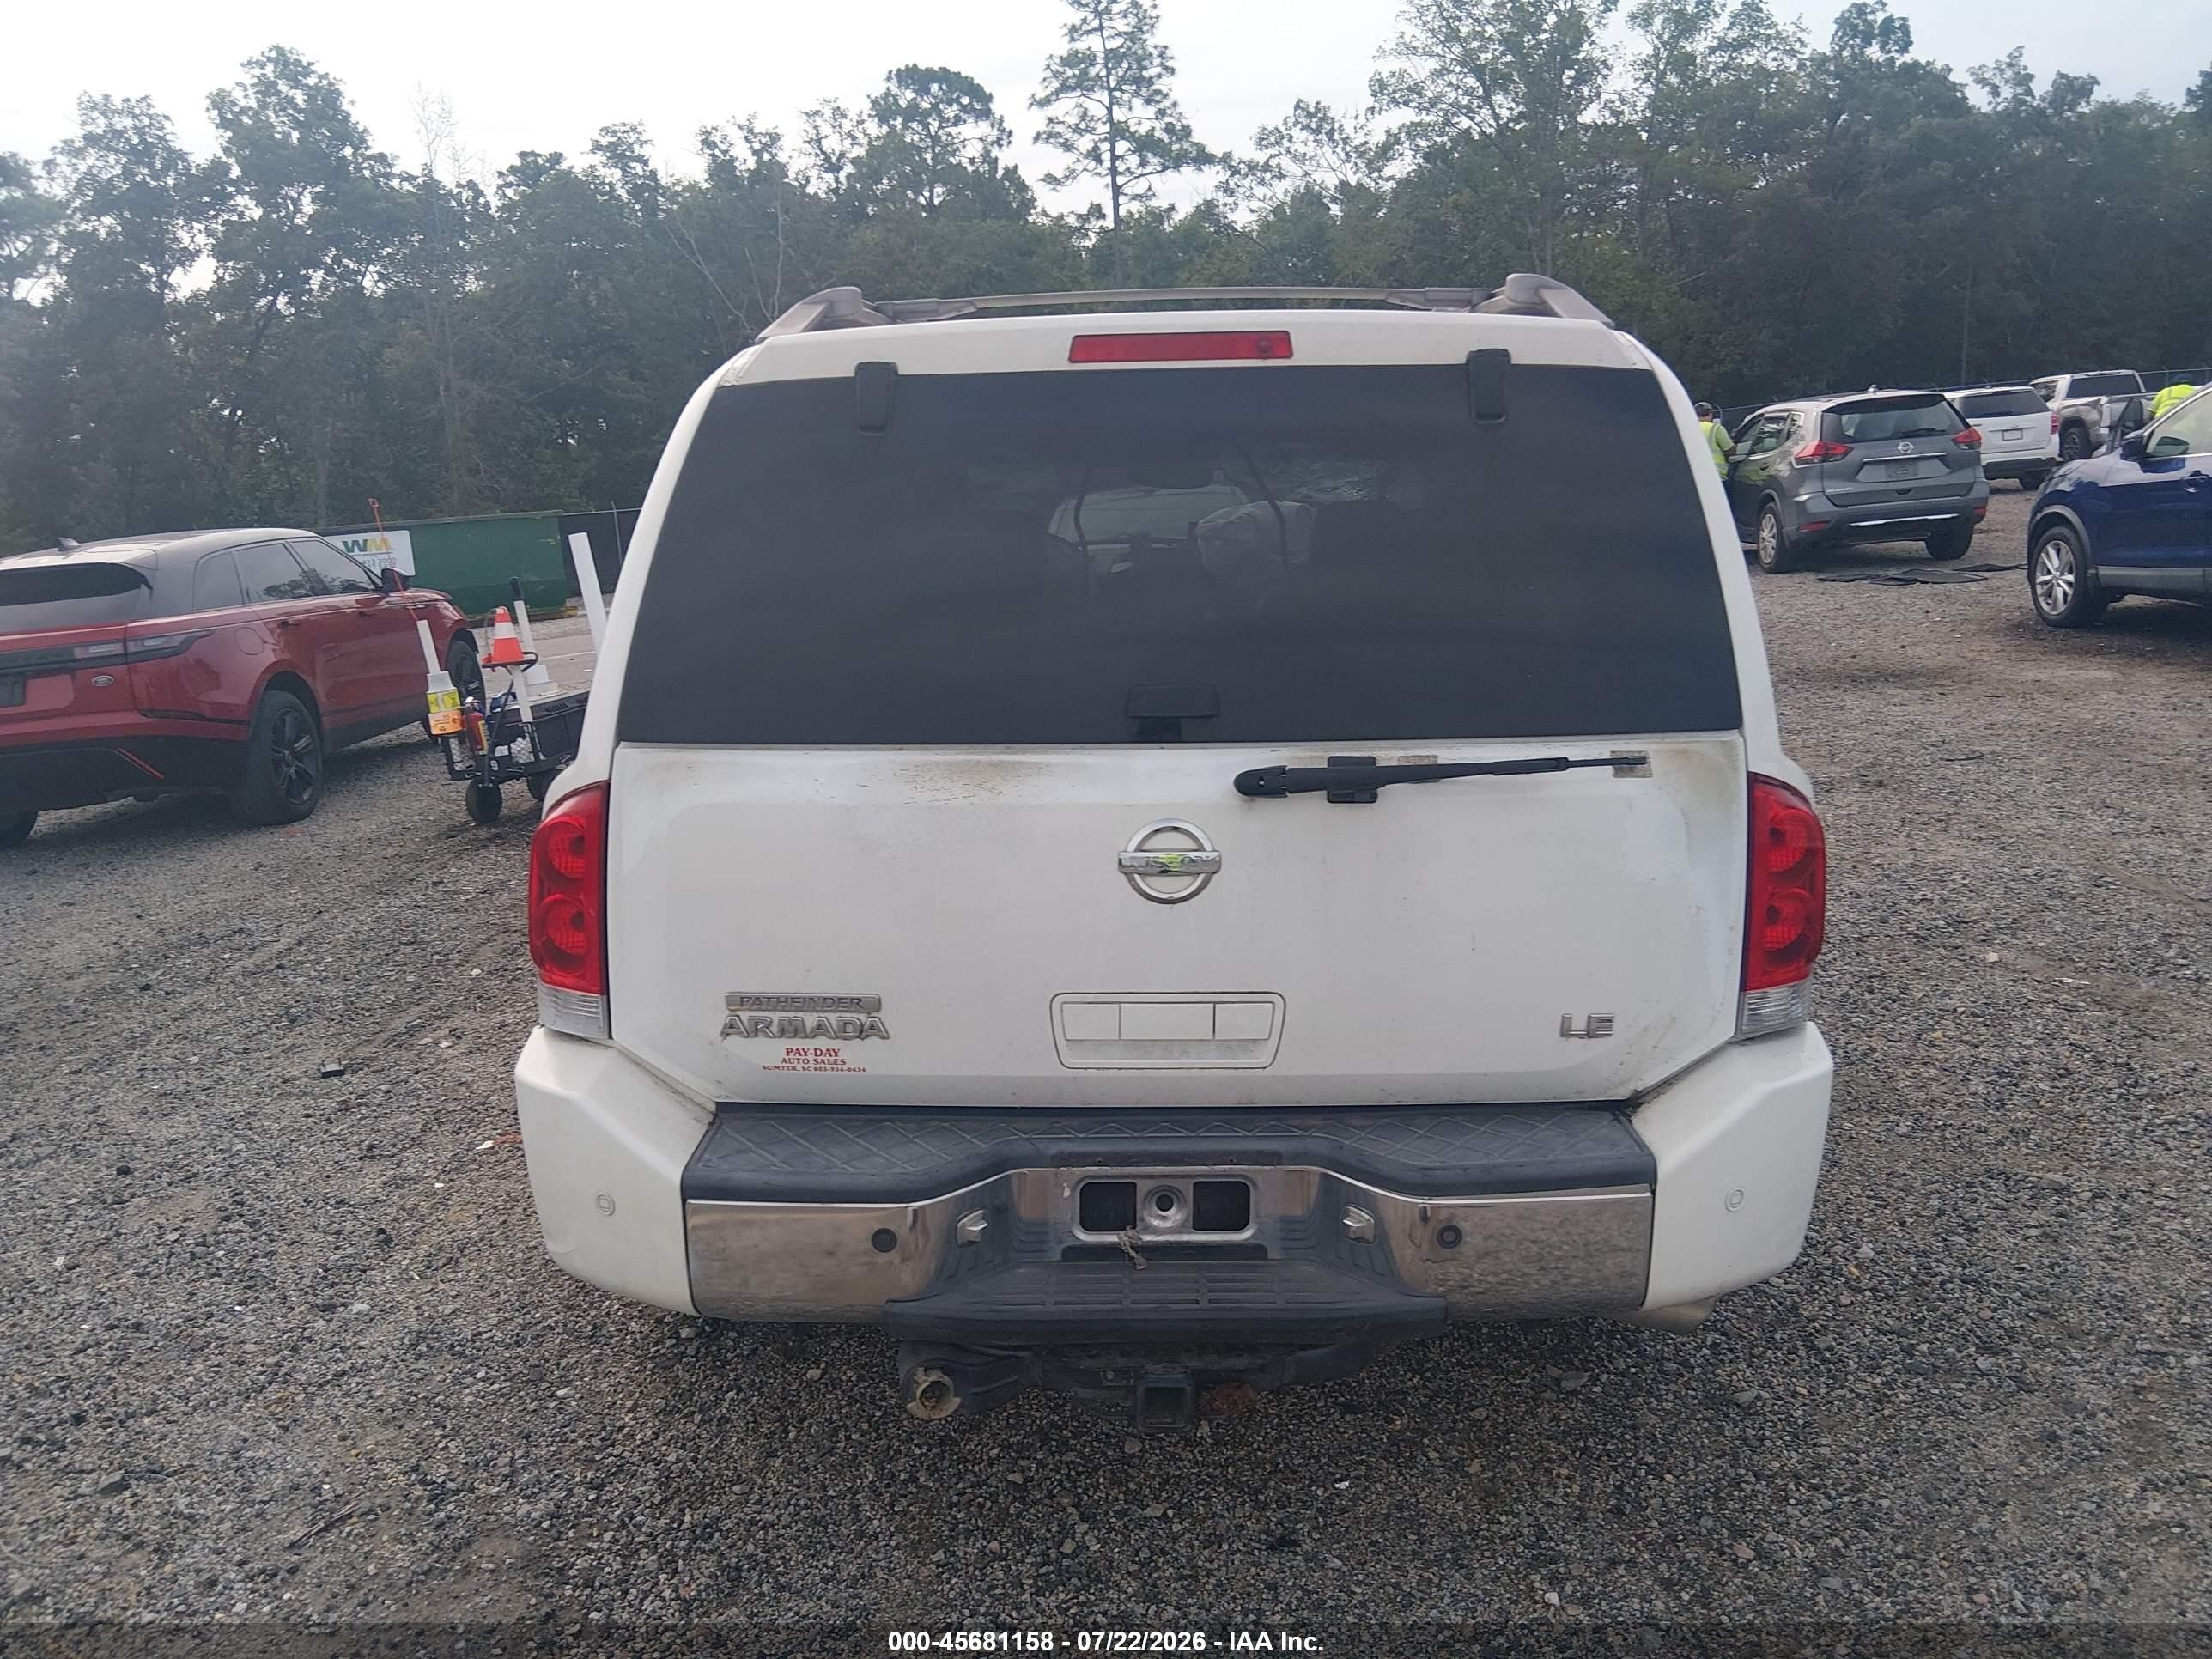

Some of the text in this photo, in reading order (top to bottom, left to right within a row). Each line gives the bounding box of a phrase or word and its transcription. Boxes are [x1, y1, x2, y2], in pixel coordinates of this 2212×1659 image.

[342, 538, 392, 553] WM
[739, 996, 864, 1010] PATHFINDER
[720, 1015, 890, 1039] ARMADA
[1559, 1012, 1615, 1038] LE
[785, 1048, 841, 1057] PAY-DAY
